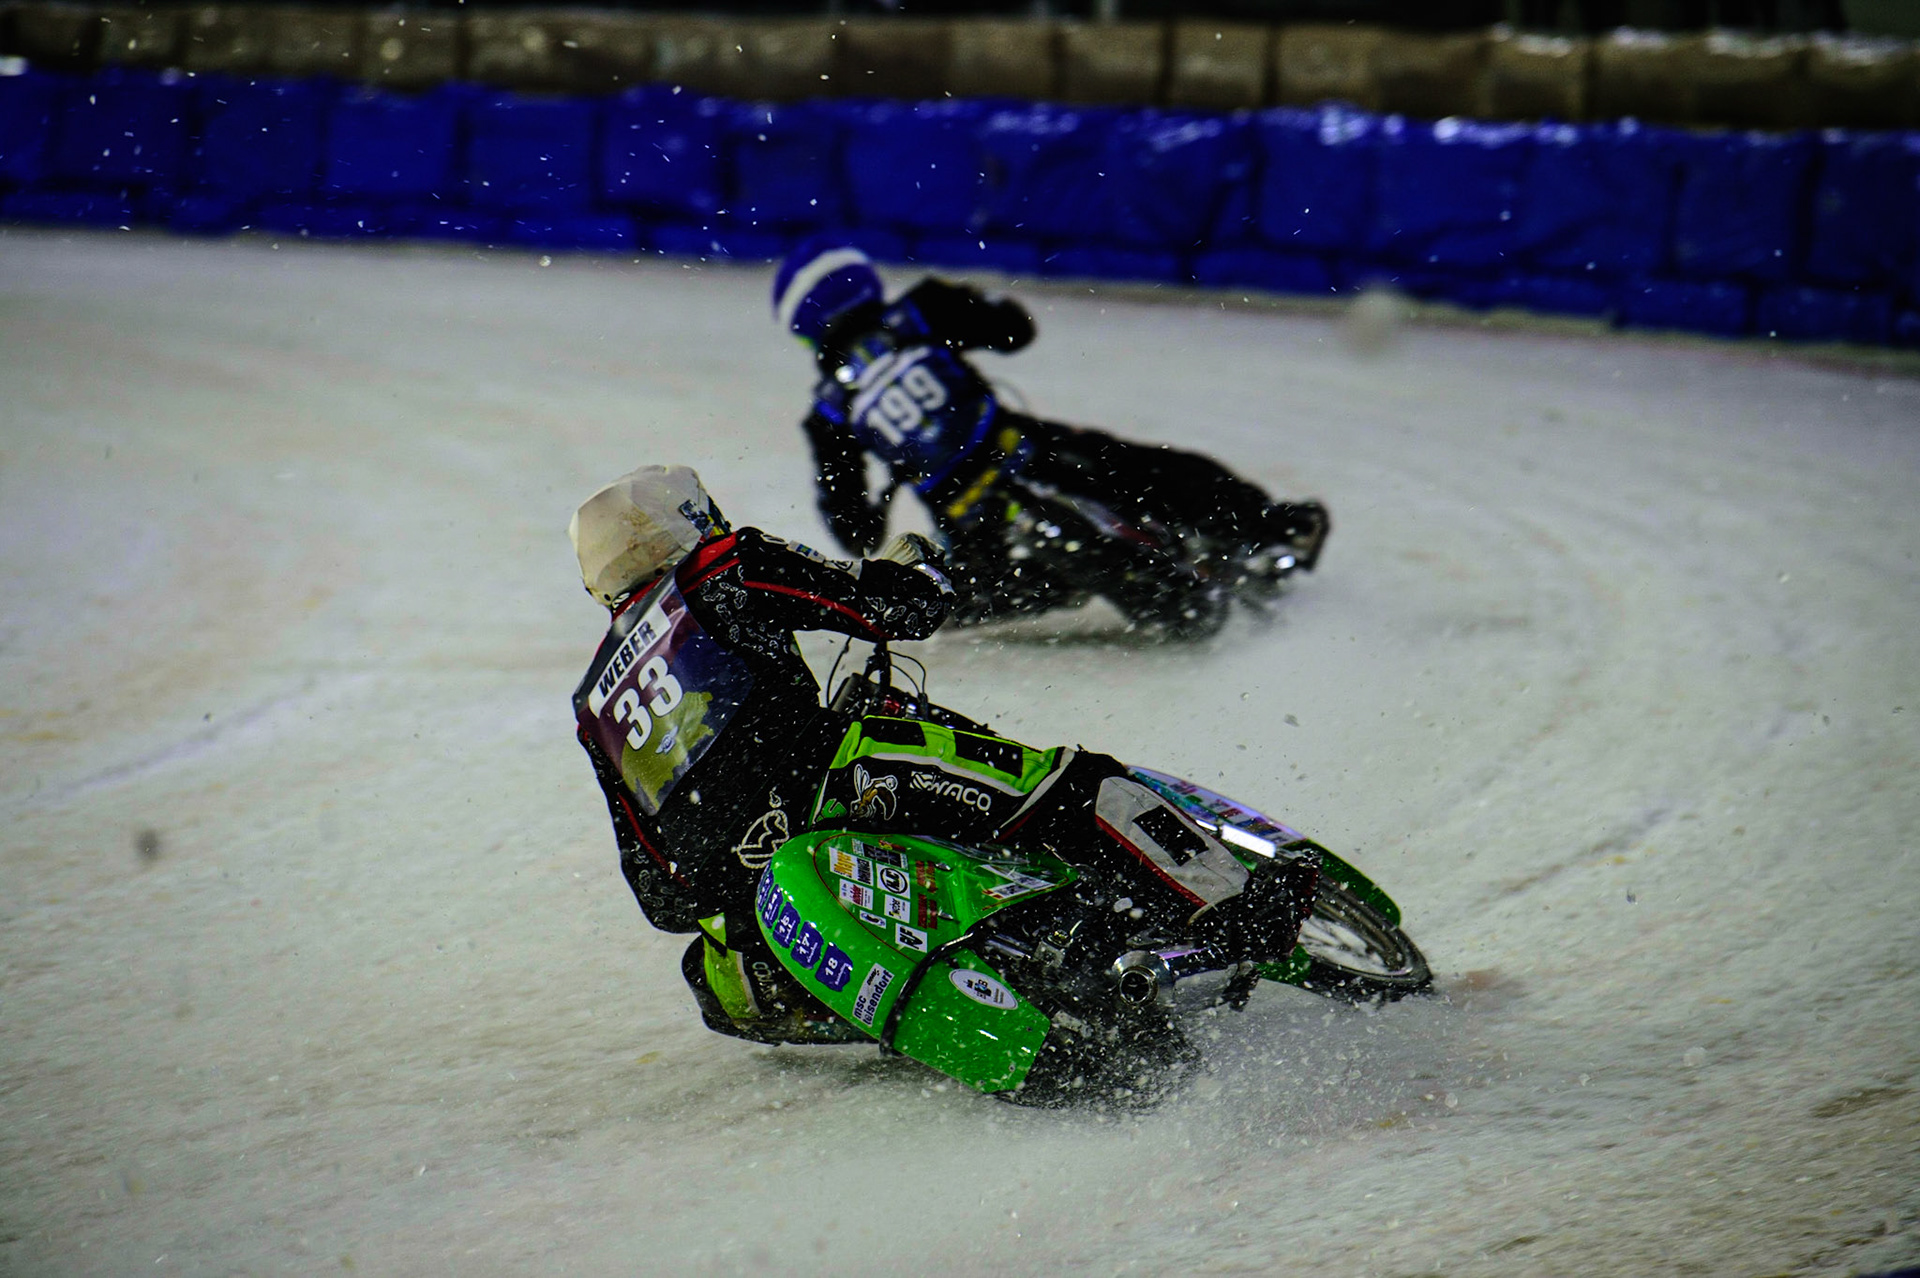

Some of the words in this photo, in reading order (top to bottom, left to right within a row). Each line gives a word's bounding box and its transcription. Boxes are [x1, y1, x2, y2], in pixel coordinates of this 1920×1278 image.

[866, 364, 948, 446] 199
[599, 621, 658, 697] WEBER
[613, 654, 683, 751] 33
[825, 957, 838, 976] 18
[854, 995, 867, 1019] msc
